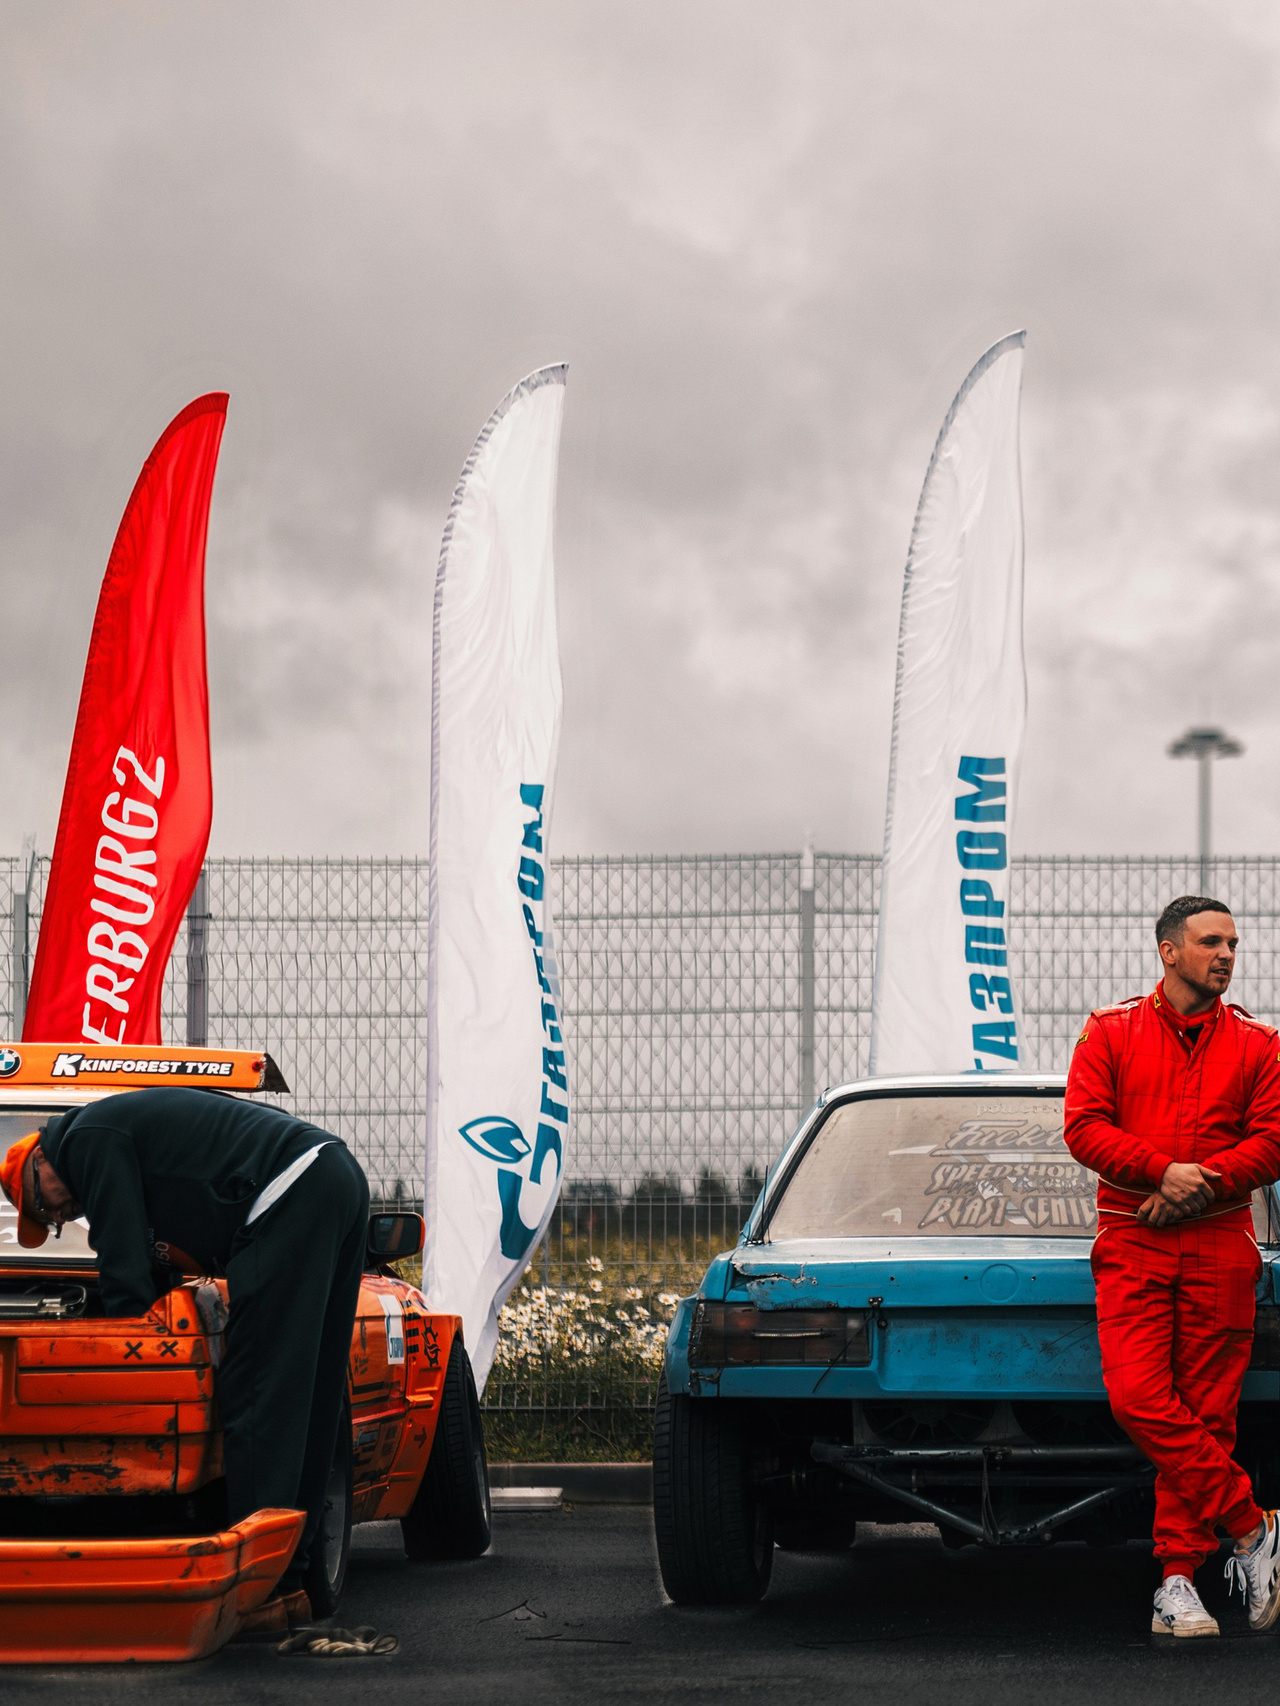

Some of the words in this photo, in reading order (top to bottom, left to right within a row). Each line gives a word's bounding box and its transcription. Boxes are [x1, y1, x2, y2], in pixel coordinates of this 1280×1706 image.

[80, 744, 165, 1045] ERBURG2
[954, 755, 1019, 1073] АЗПРОМ
[79, 1059, 182, 1074] KINFOREST
[184, 1061, 232, 1076] TYRE
[924, 1162, 1082, 1196] SPEEDSHOP
